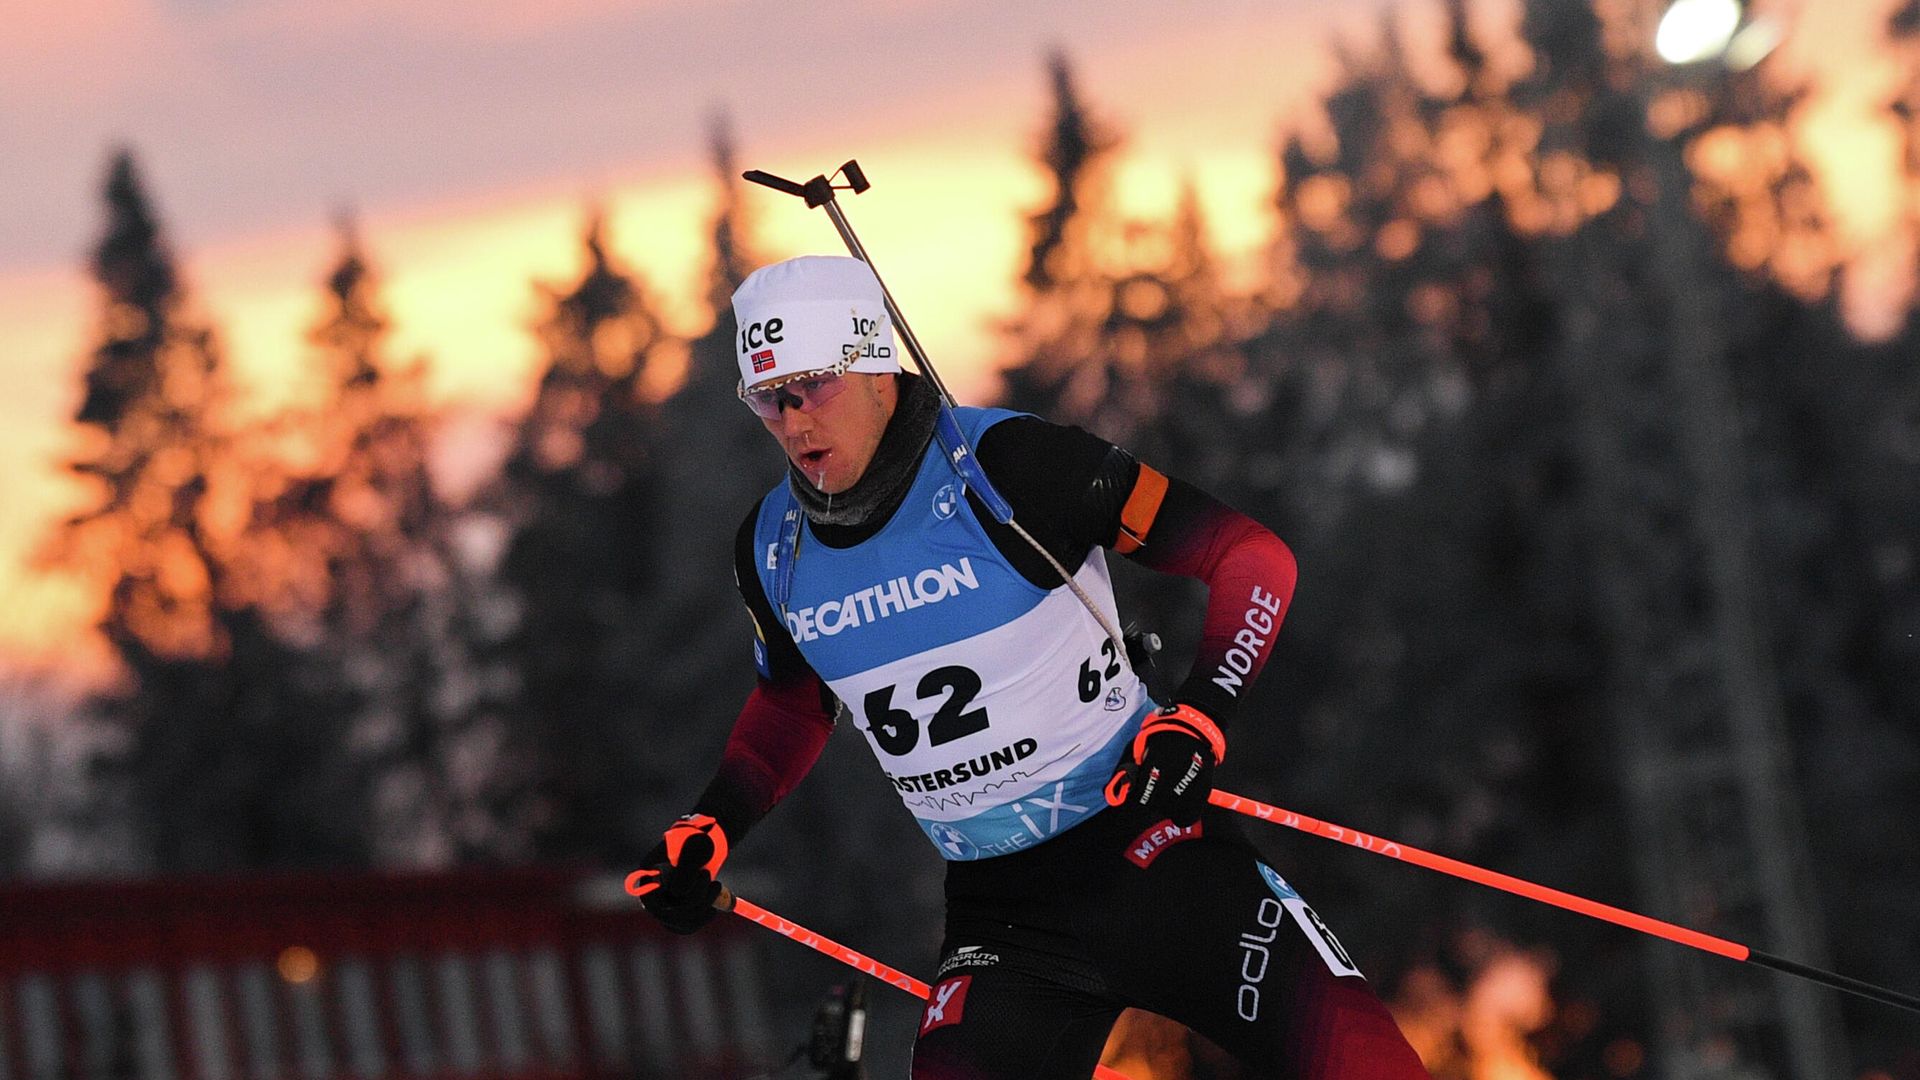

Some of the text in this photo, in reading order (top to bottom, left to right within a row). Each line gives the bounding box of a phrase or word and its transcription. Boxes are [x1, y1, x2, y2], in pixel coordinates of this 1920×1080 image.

[787, 557, 980, 643] DECATHLON
[1212, 585, 1281, 697] NORGE
[864, 665, 990, 756] 62
[1078, 637, 1121, 703] 62
[1173, 751, 1203, 796] KINETIX
[980, 832, 1032, 856] THE
[1237, 898, 1284, 1022] odlo
